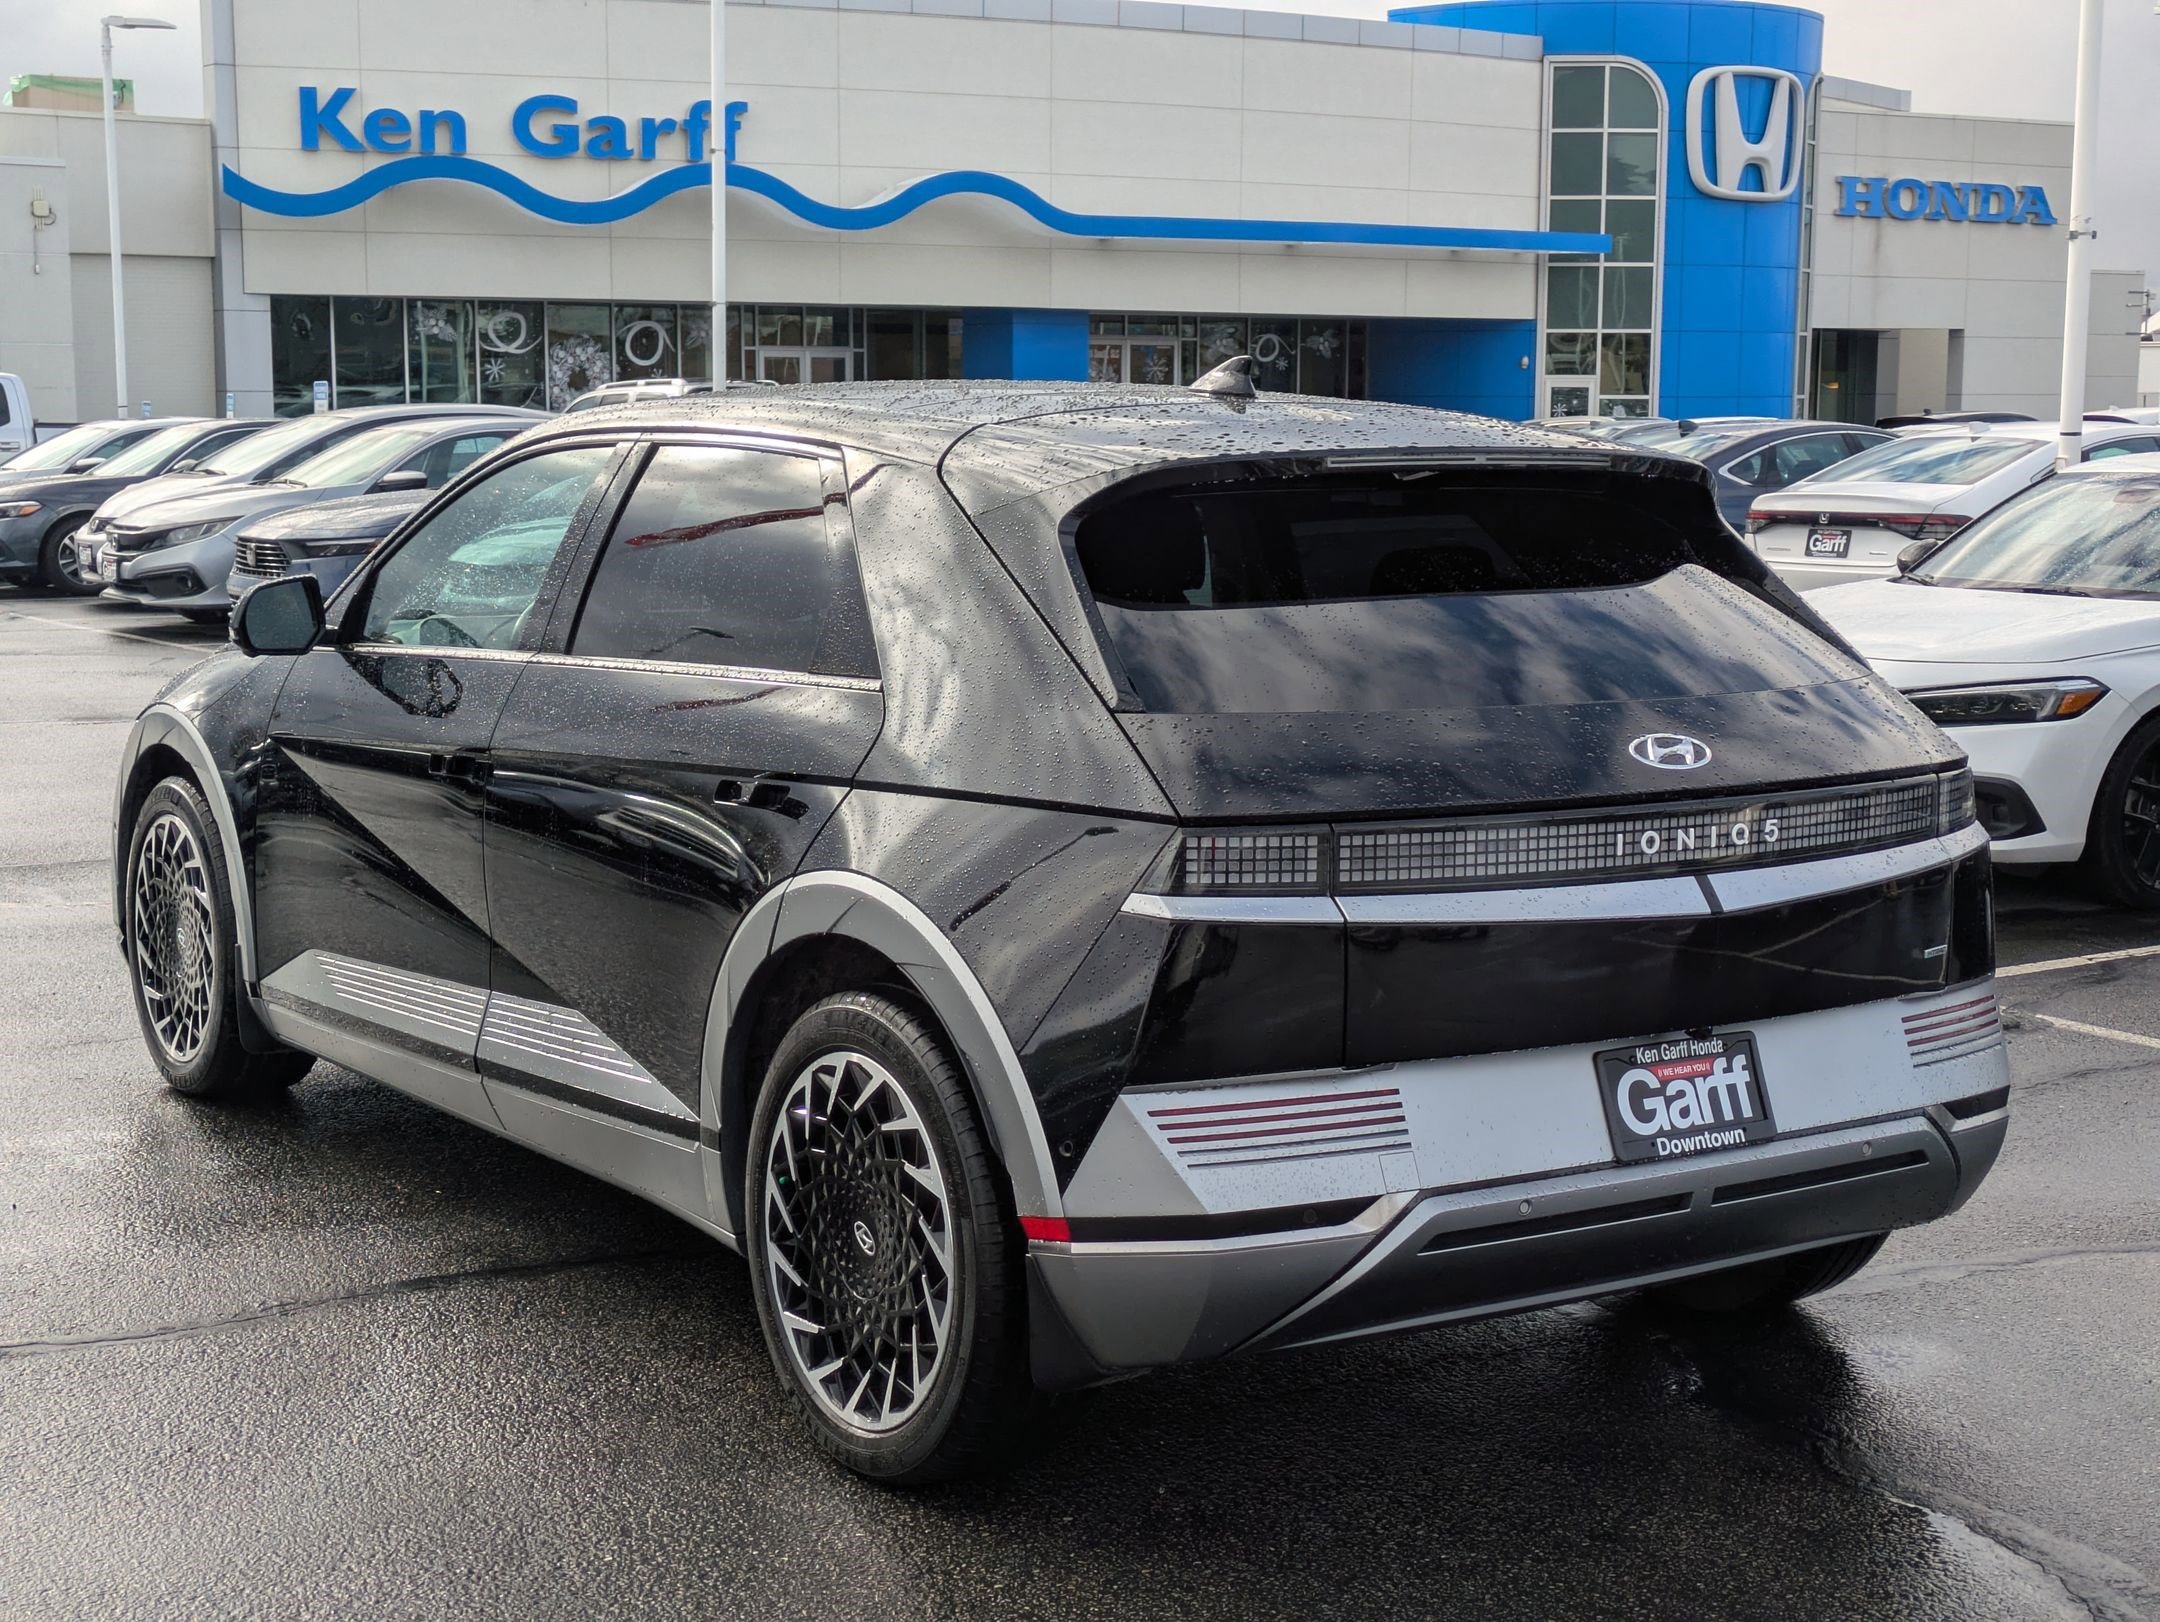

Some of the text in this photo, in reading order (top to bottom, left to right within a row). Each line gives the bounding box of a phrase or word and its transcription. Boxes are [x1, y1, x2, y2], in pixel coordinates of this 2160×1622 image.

[299, 86, 749, 163] Ken Garff
[1834, 175, 2058, 226] HONDA
[1809, 534, 1847, 552] Garff
[1635, 1037, 1724, 1065] Ken Garff Honda
[1662, 1062, 1706, 1076] WE HEAR YOU
[1616, 1054, 1753, 1136] Garff
[1656, 1127, 1746, 1156] Downtown
